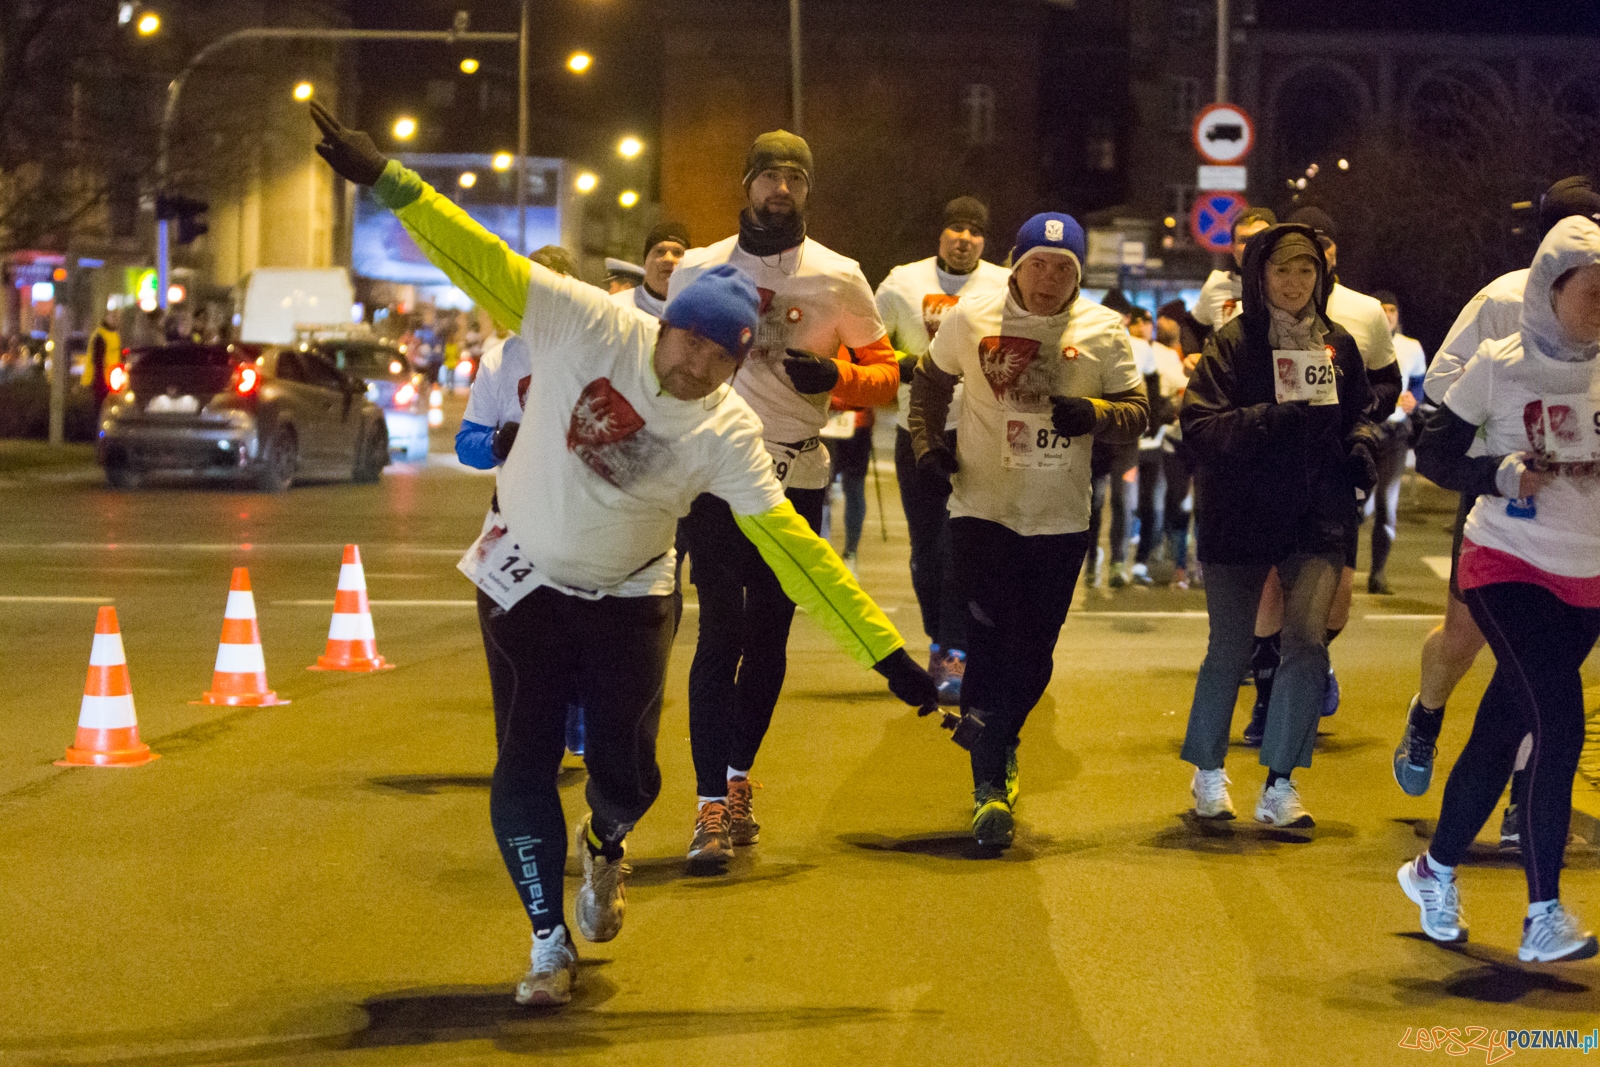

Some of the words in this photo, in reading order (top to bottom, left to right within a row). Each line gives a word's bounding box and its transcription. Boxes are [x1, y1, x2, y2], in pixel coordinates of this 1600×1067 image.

[1304, 365, 1334, 385] 625
[500, 556, 532, 583] 14
[507, 835, 549, 915] kalenji
